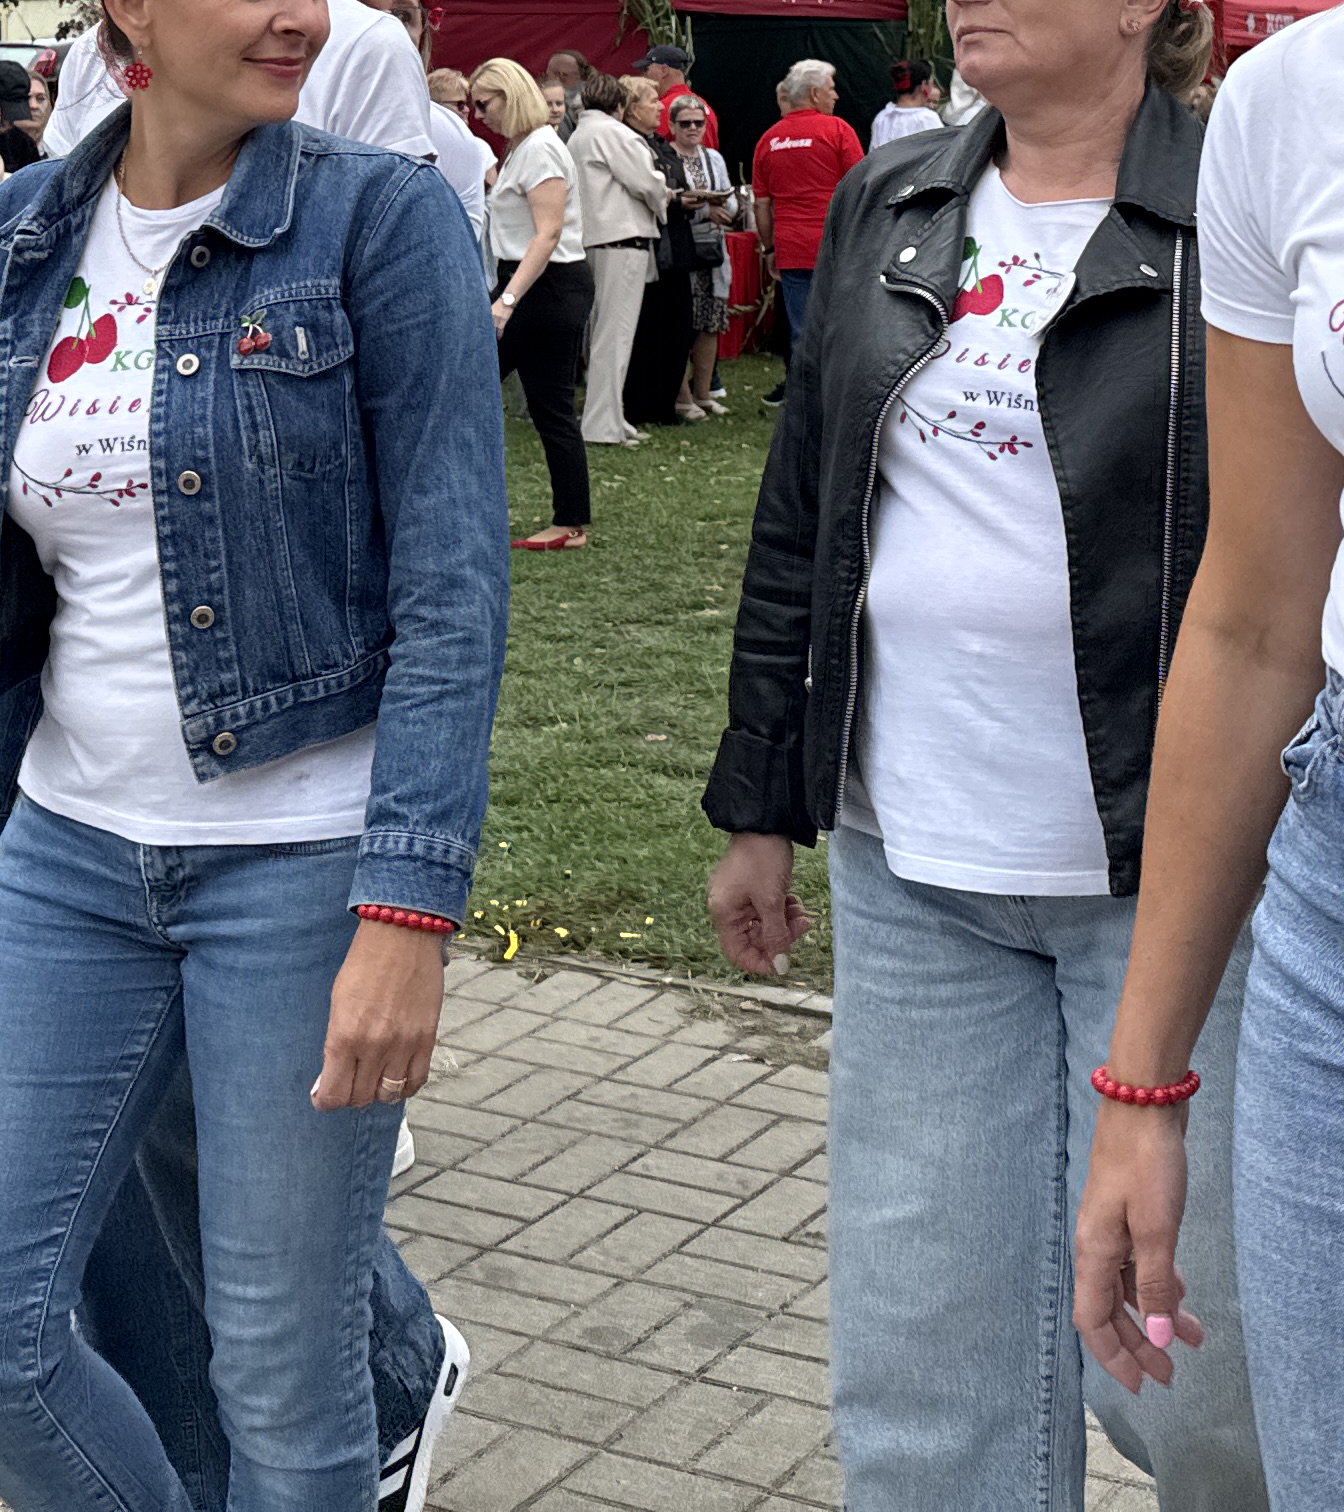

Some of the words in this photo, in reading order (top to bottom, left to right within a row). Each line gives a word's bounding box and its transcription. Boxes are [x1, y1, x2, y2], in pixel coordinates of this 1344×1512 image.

[109, 348, 156, 373] KG
[931, 340, 1032, 374] isie
[24, 388, 150, 425] Wisie
[985, 389, 1040, 412] Wiśn
[97, 434, 150, 454] Wiśn
